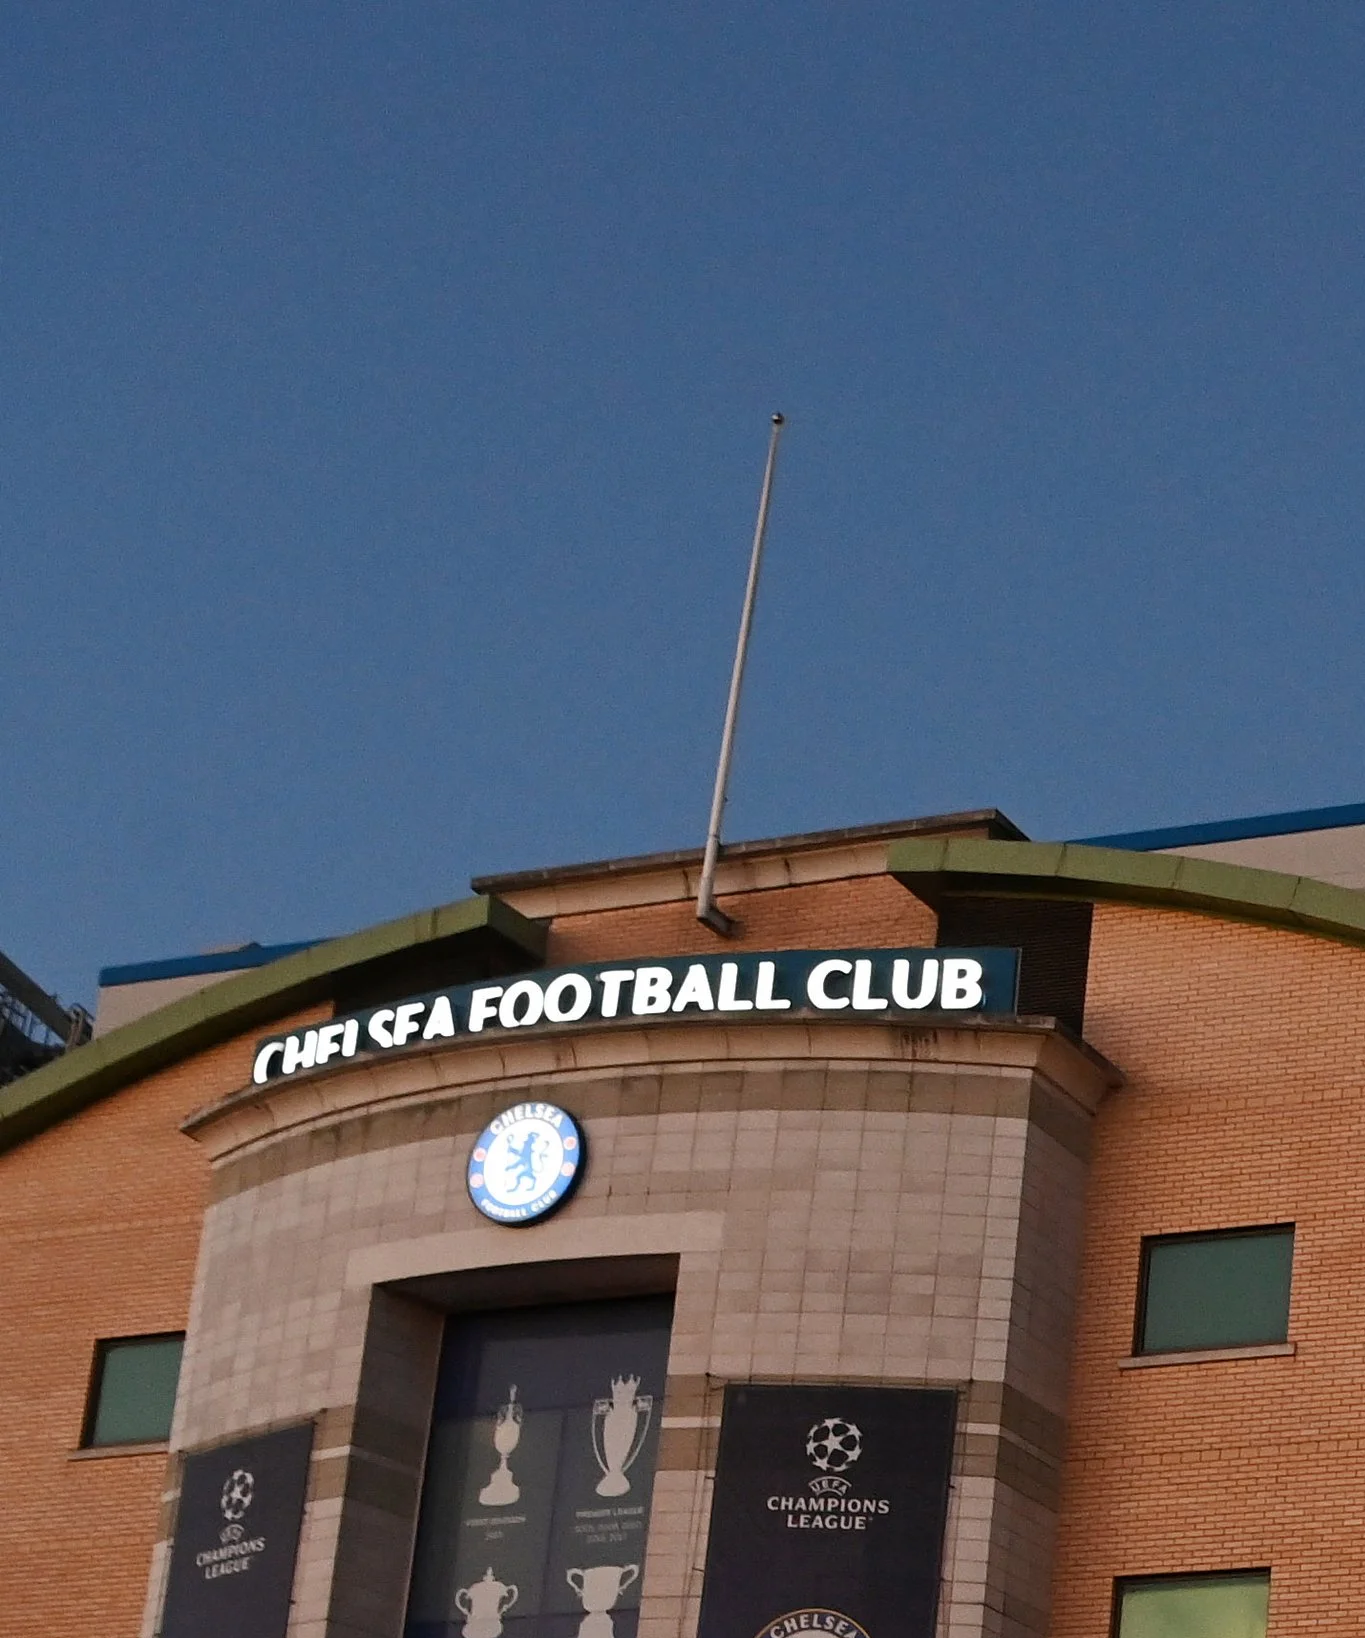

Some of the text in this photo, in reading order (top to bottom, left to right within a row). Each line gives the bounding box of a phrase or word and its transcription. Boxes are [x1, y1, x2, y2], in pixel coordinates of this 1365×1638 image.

[468, 961, 791, 1032] FOOTBALL
[807, 958, 984, 1010] CLUB
[490, 1103, 563, 1135] CHELSEA
[810, 1480, 849, 1494] UEFA
[767, 1496, 890, 1514] CHAMPIONS
[787, 1515, 867, 1530] LEAGUE
[196, 1537, 265, 1567] CHAMPIONS
[205, 1557, 250, 1579] LEAGUE
